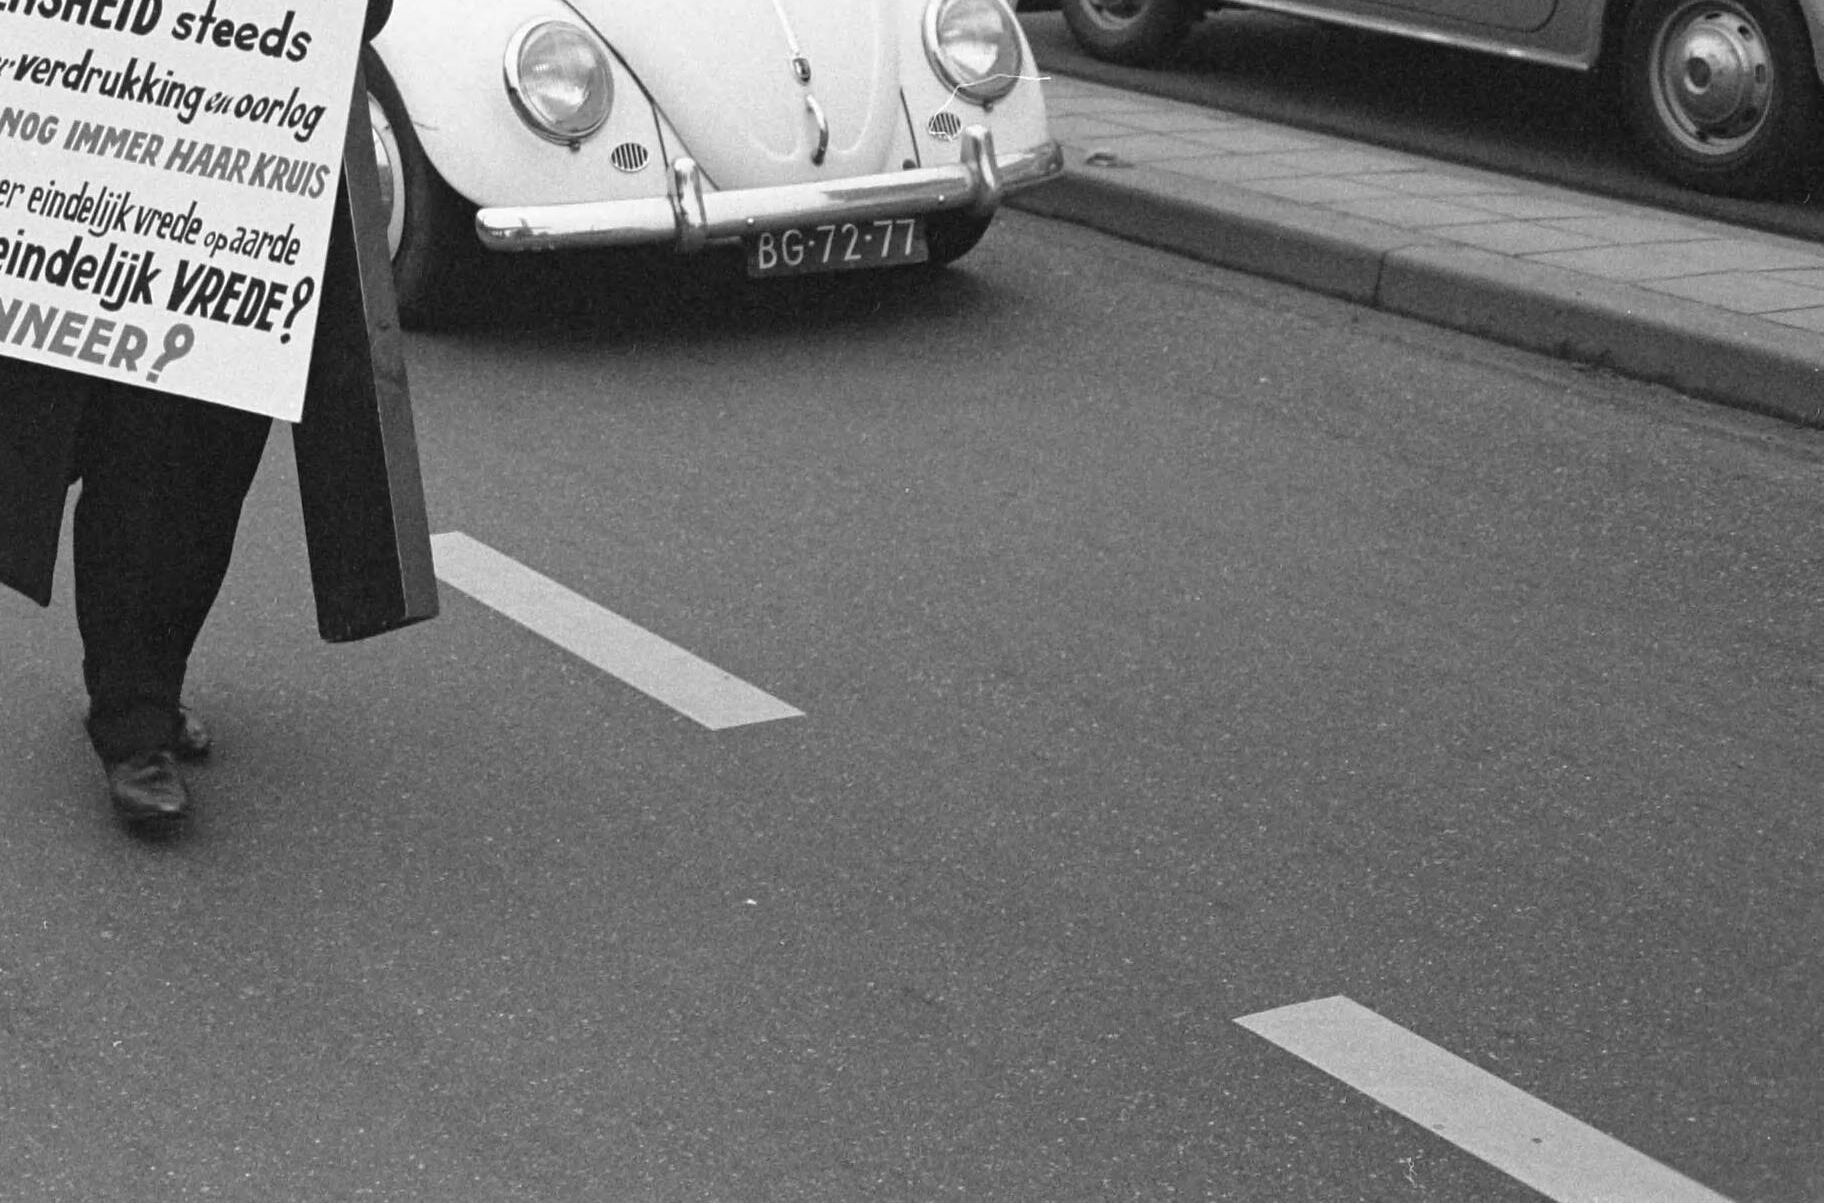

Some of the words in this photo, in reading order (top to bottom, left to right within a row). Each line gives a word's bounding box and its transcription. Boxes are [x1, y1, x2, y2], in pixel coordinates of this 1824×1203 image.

[12, 47, 207, 125] verdrukking
[203, 90, 234, 115] en
[232, 85, 327, 143] oorlog
[62, 119, 164, 167] IMMER
[162, 137, 251, 184] HAAR
[247, 151, 331, 199] KRUIS
[25, 178, 136, 238] eindelijk
[132, 199, 203, 246] vrede
[202, 230, 228, 259] op
[227, 222, 301, 266] aarde
[165, 258, 315, 345] VREDE?
